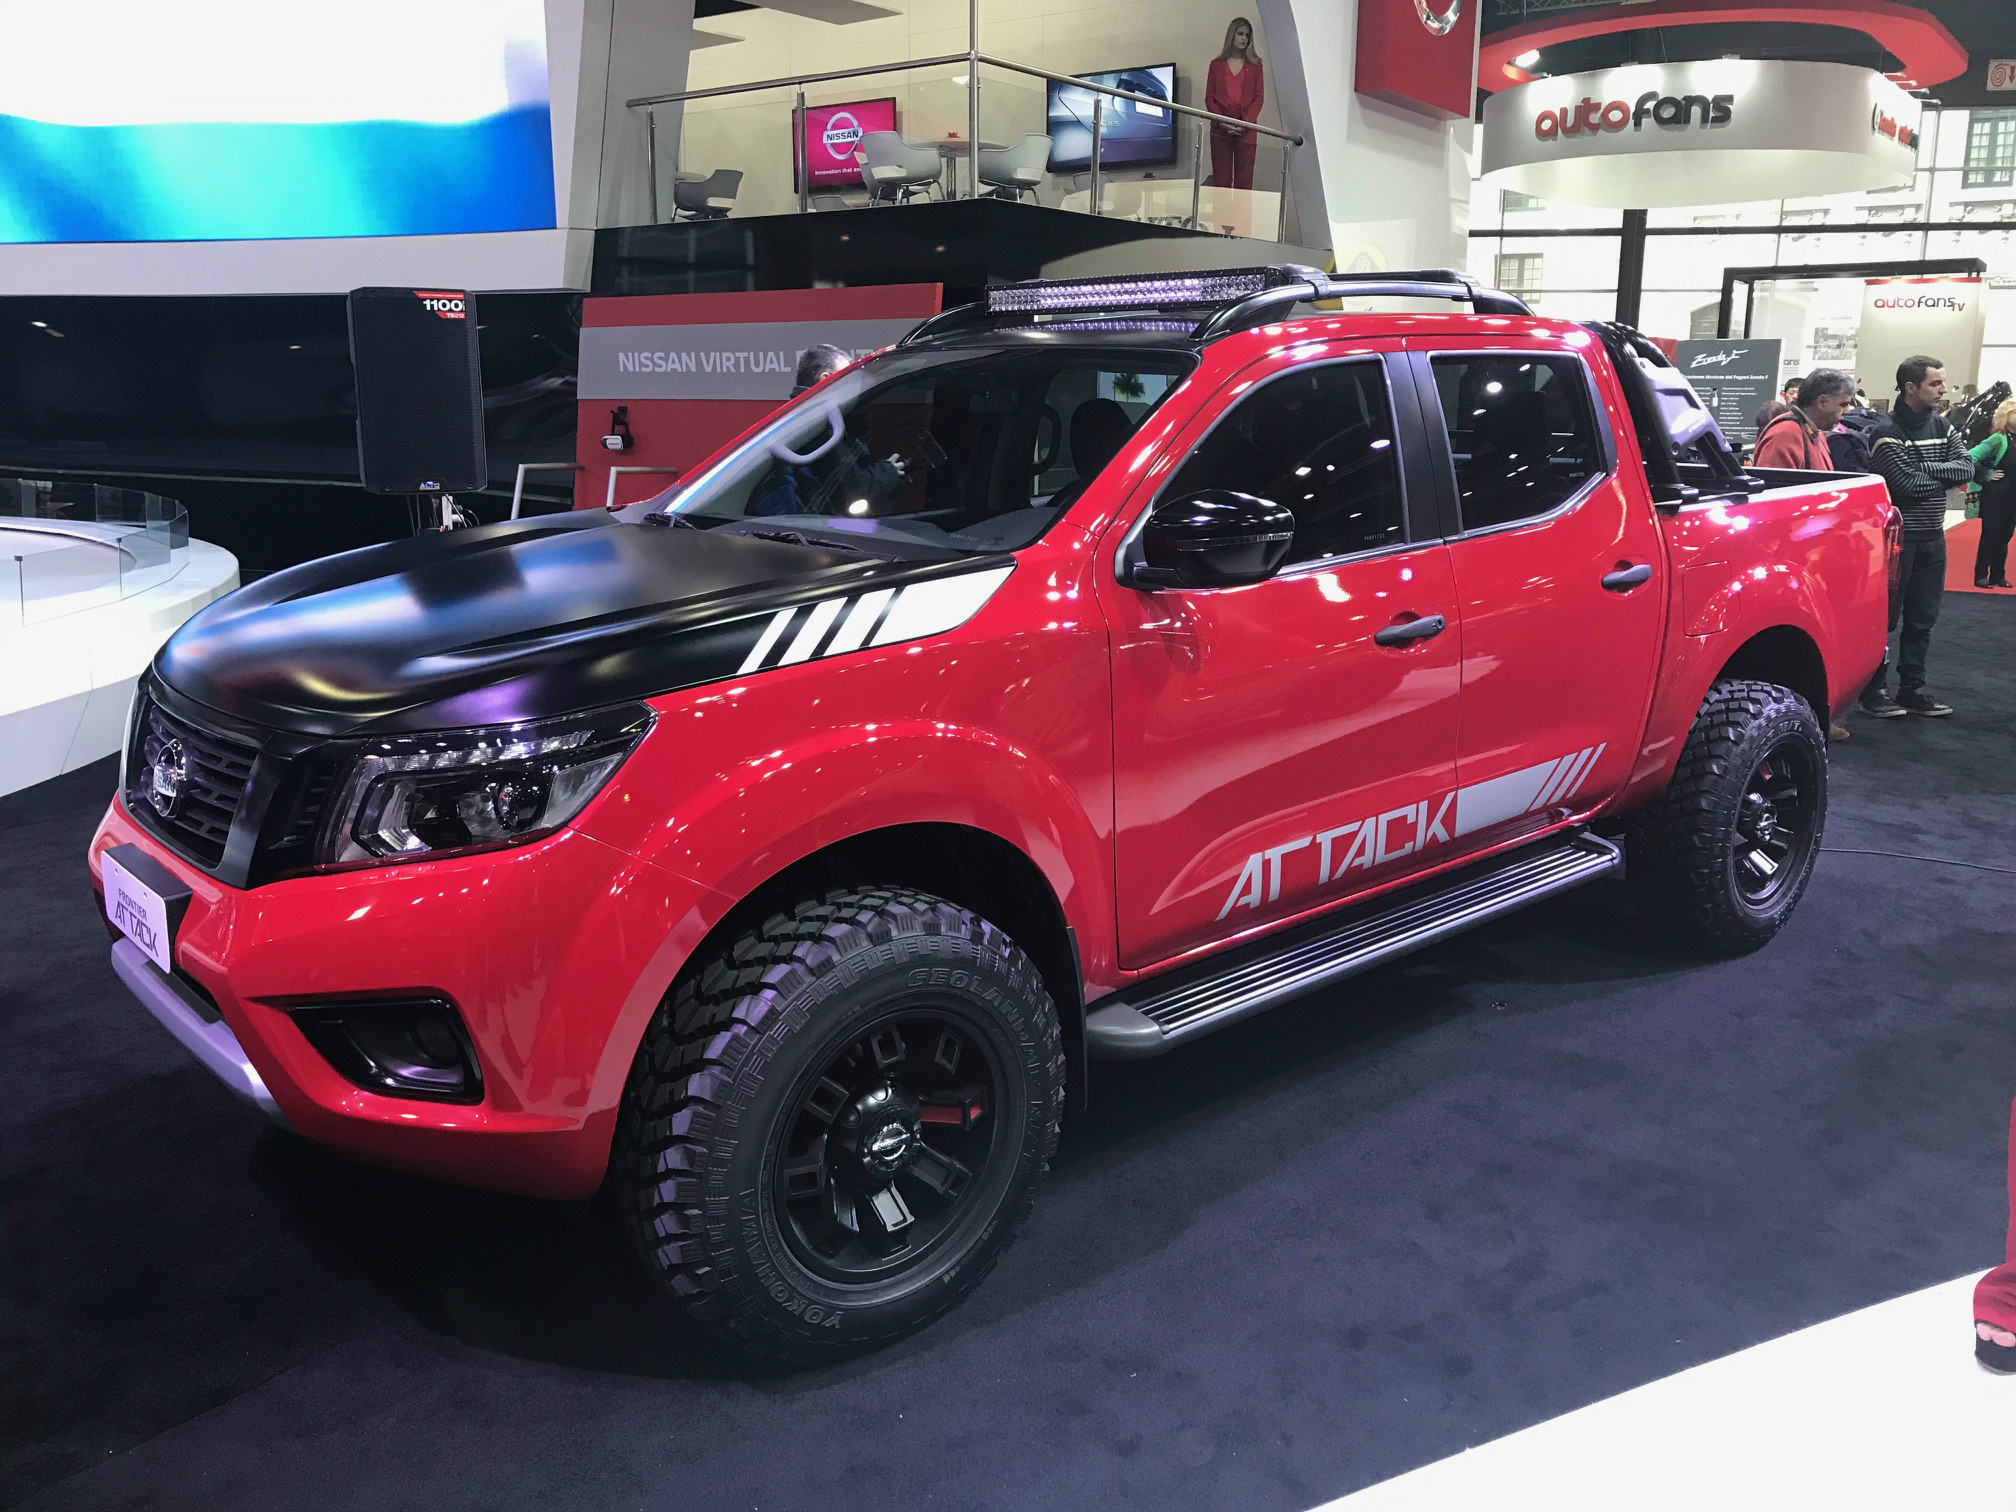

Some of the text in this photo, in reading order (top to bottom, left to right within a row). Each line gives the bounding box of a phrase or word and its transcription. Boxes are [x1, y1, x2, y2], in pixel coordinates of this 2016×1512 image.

[826, 130, 859, 142] NISSAN
[815, 168, 841, 176] Innovation
[618, 352, 697, 373] NISSAN
[699, 351, 791, 373] VIRTUAL
[118, 888, 147, 921] FRONTIER
[115, 900, 159, 958] ATTACK
[907, 967, 1041, 1086] GEOLANDAR
[739, 1188, 844, 1329] YOKOHAMA
